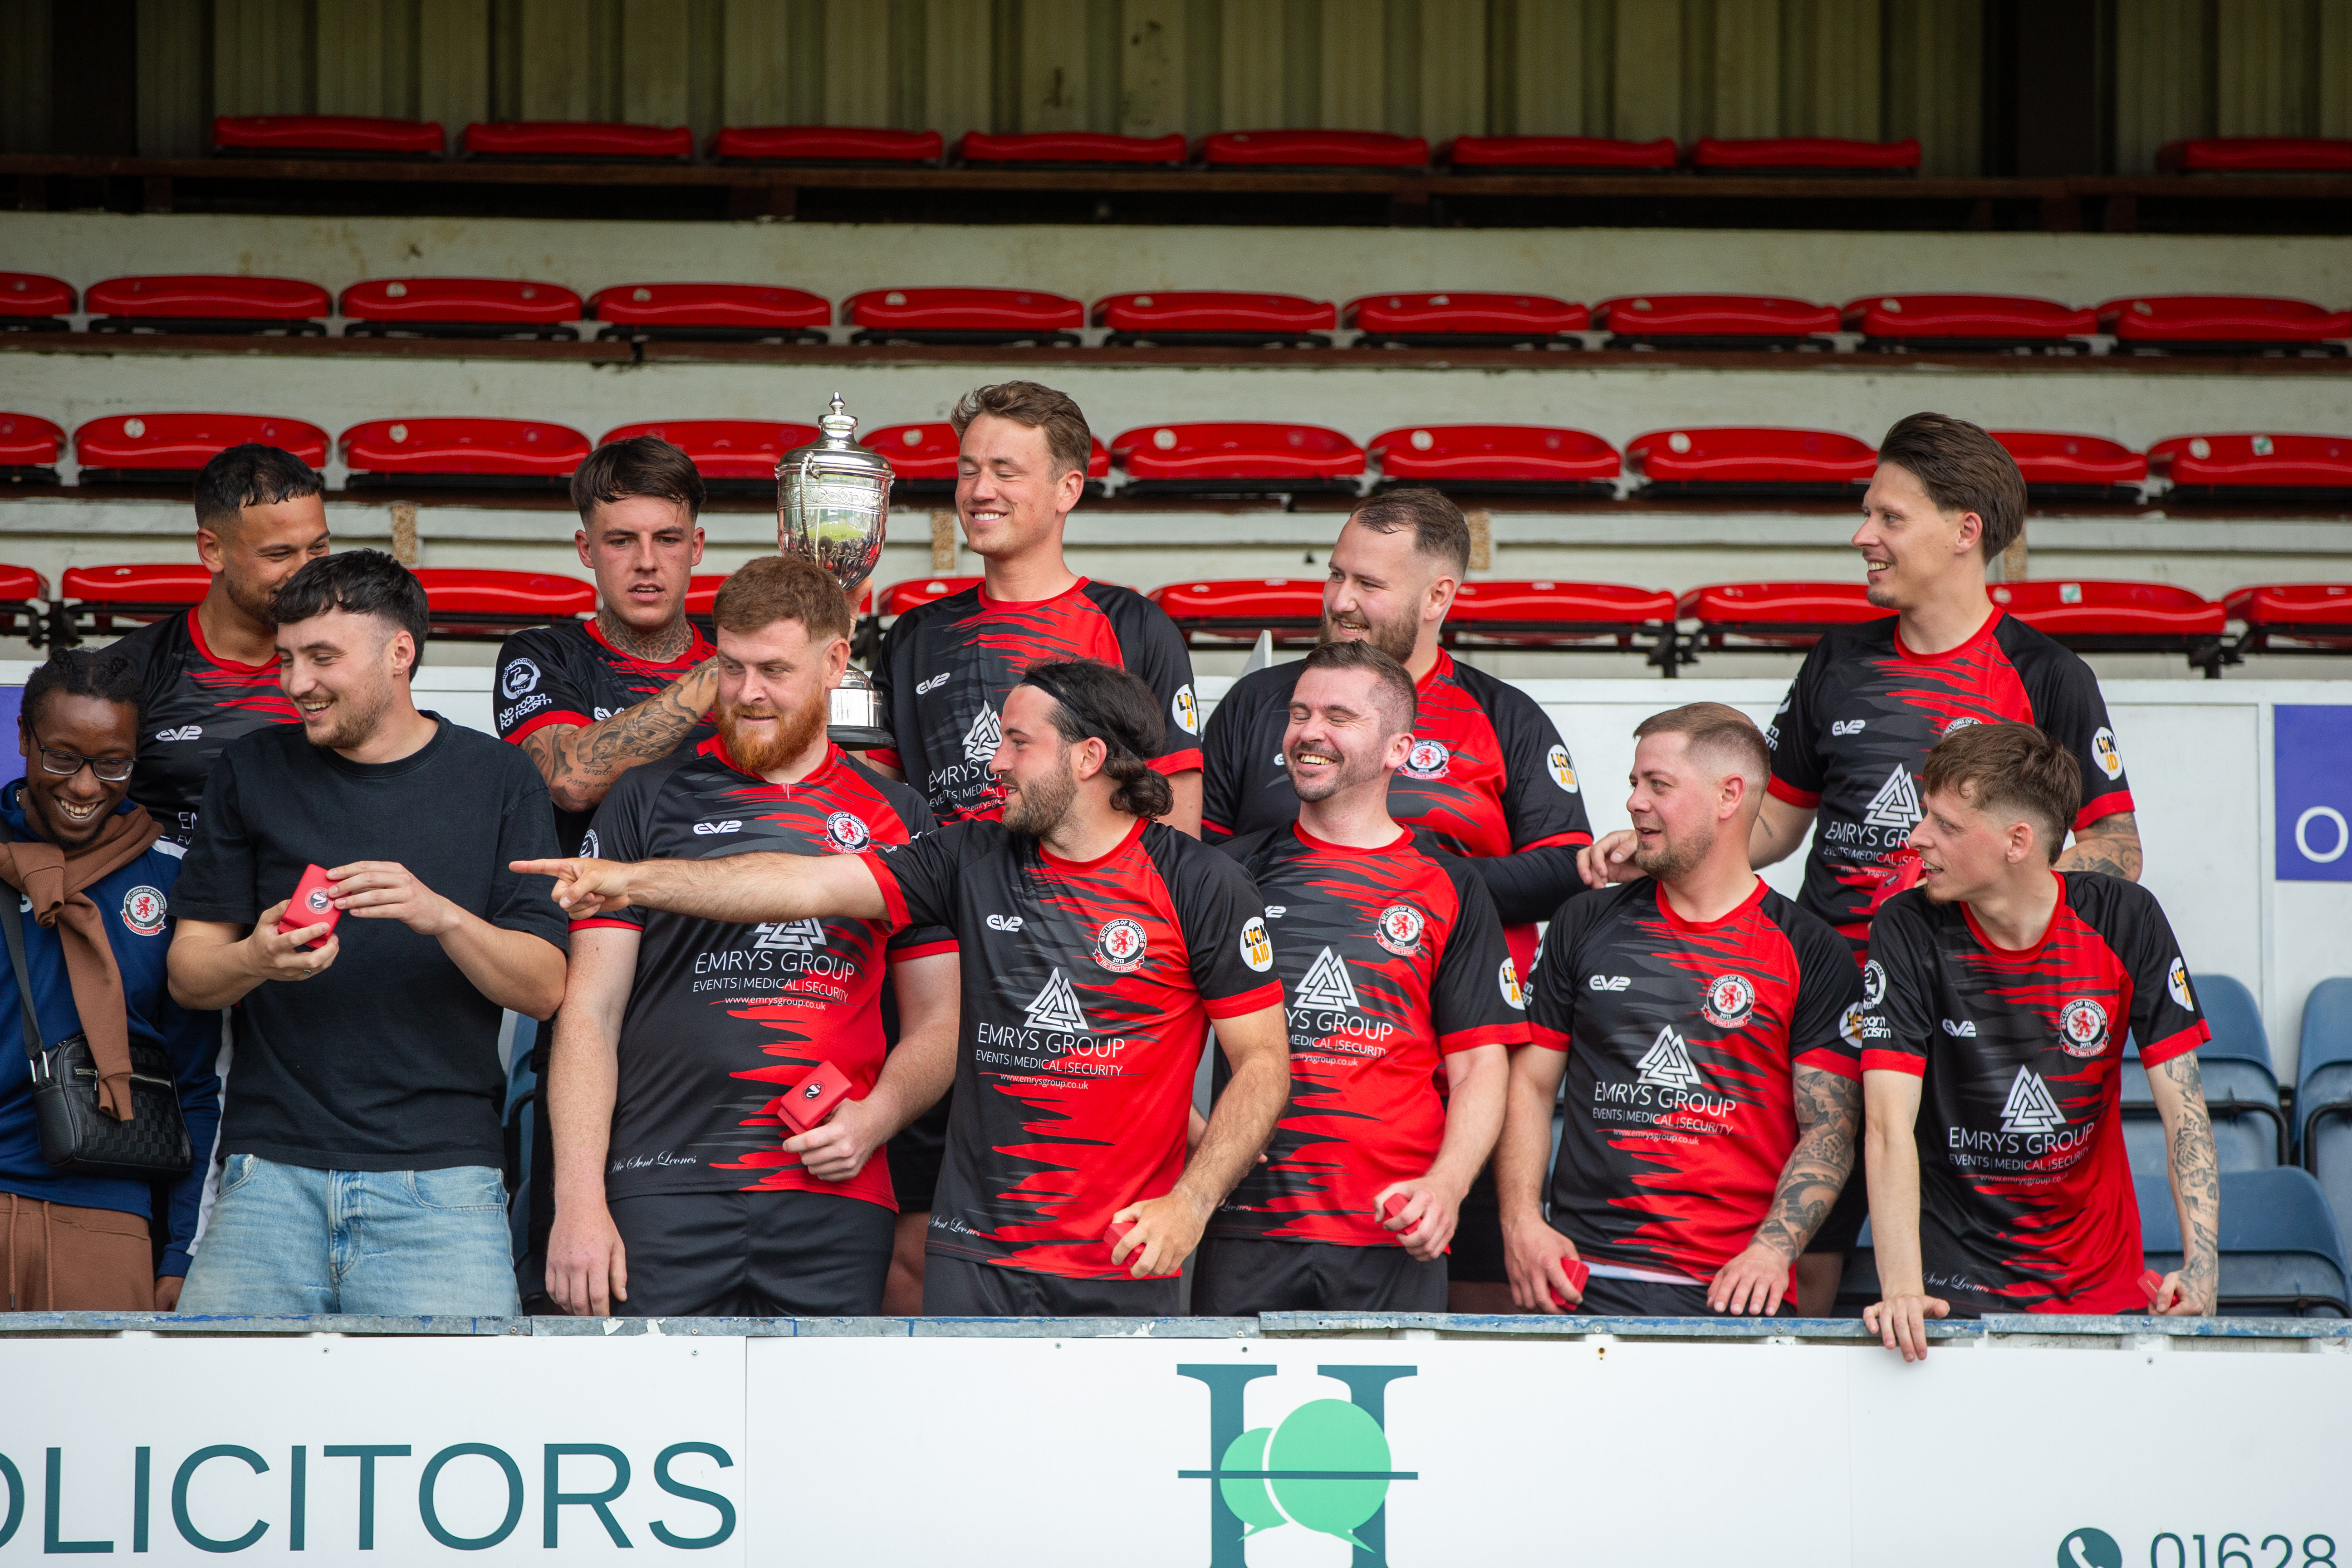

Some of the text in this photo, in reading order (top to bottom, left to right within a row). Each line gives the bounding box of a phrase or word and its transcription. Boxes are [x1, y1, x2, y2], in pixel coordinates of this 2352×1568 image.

[511, 659, 534, 668] WYCOMBE
[500, 693, 545, 722] No room
[515, 699, 552, 719] racism
[1551, 753, 1572, 770] LION
[929, 760, 980, 793] EMRYS
[1560, 769, 1575, 785] AID
[832, 813, 843, 822] LIONS
[850, 814, 868, 834] WYCOMBE
[1825, 821, 1879, 847] EMRYS
[150, 890, 164, 909] WYCOMBE
[1106, 921, 1120, 931] LIONS
[1129, 921, 1145, 942] WYCOMBE
[1244, 924, 1267, 948] LION
[1252, 943, 1269, 965] AID
[695, 951, 854, 983] EMRYS GROUP
[725, 997, 826, 1010] www.emrysgroup.co.uk
[1317, 1012, 1393, 1041] GROUP
[978, 1023, 1125, 1058] EMRYS GROUP
[1000, 1073, 1088, 1089] www.emrysgroup.co.uk
[1595, 1081, 1736, 1117] EMRYS GROUP
[1613, 1128, 1699, 1146] www.emrysgroup.co.uk
[1949, 1122, 2094, 1154] EMRYS GROUP
[0, 1441, 737, 1554] LICITORS
[2150, 1532, 2337, 1568] 01628
